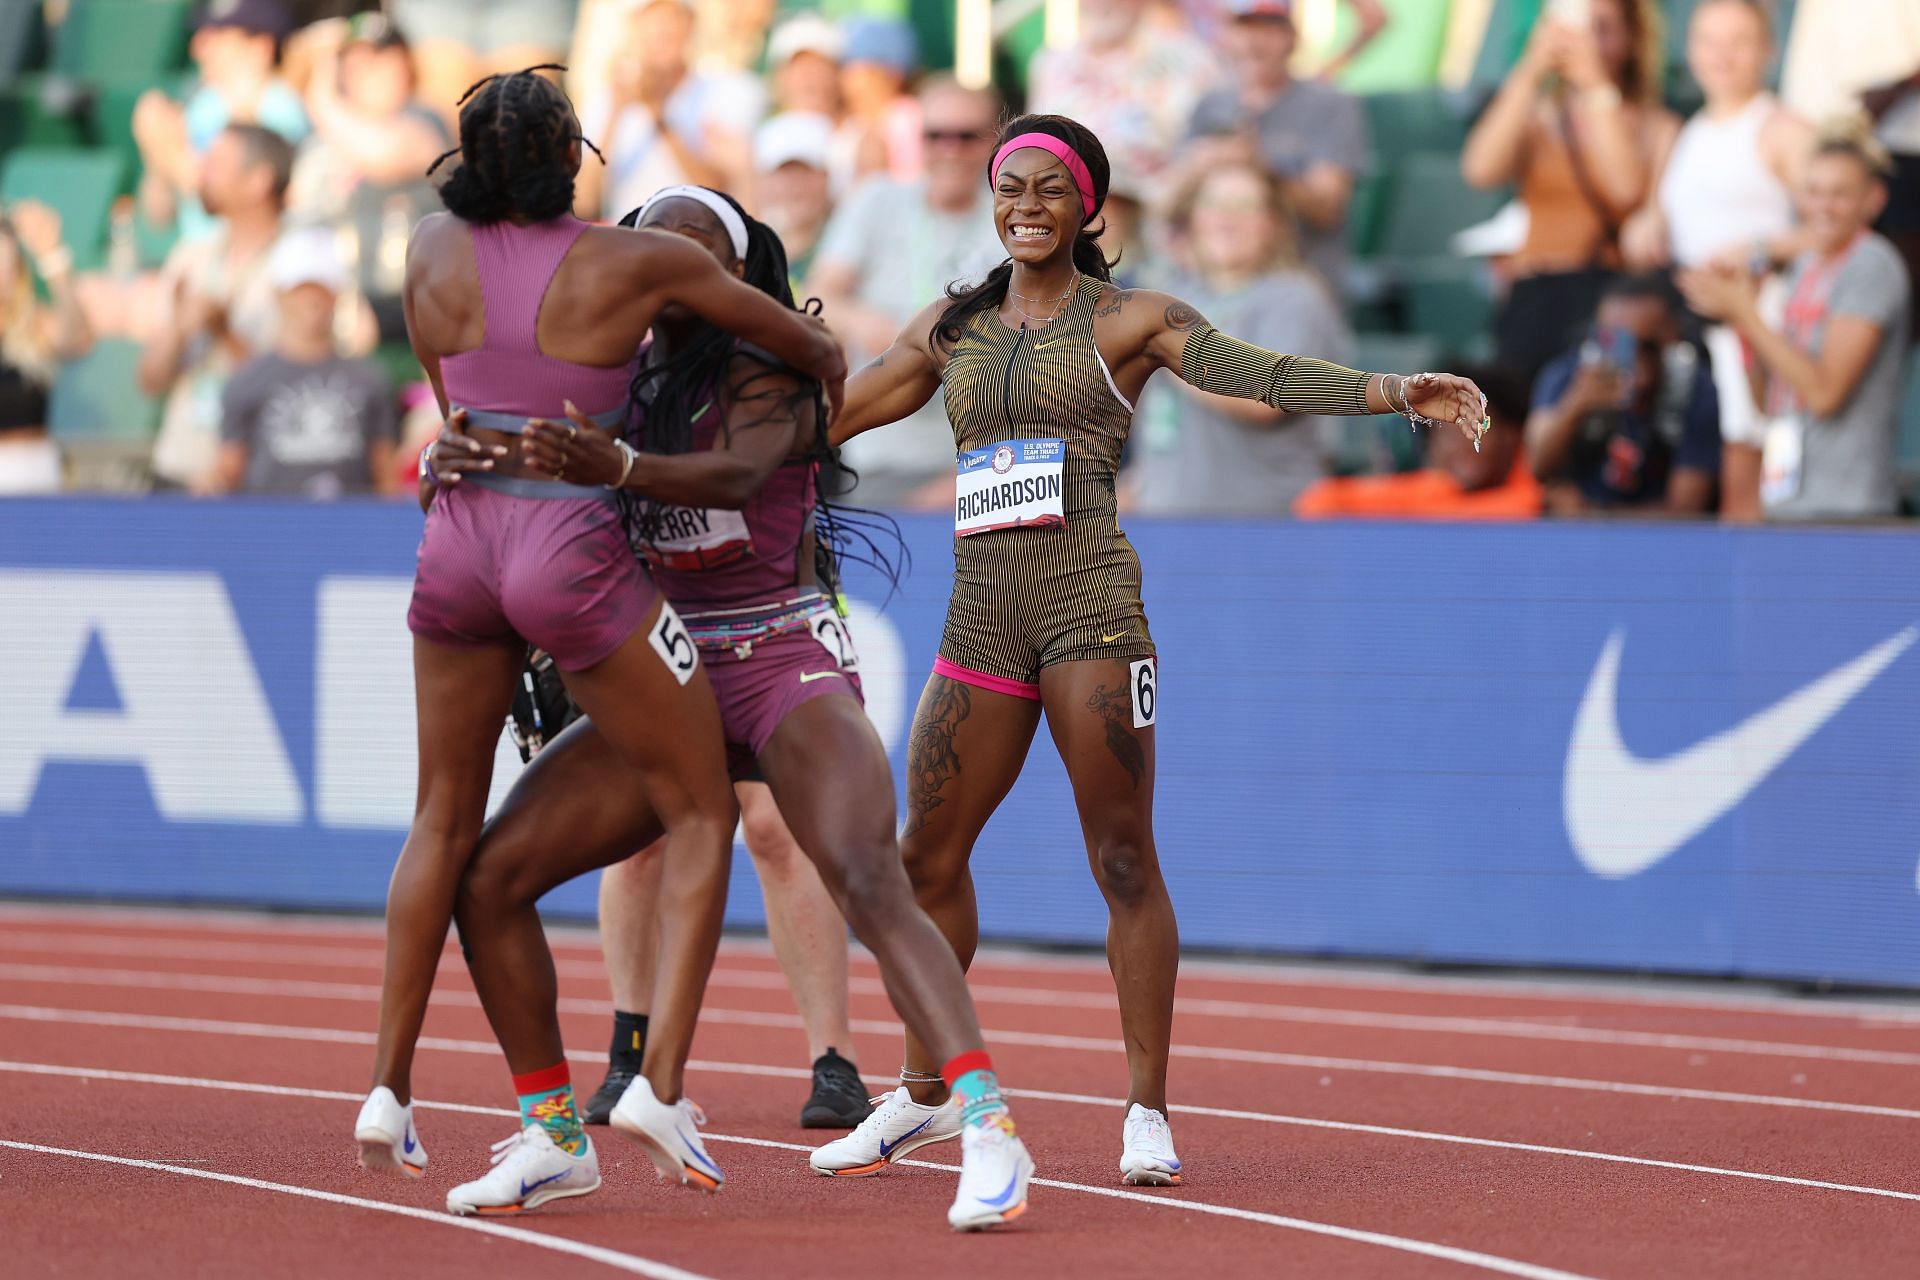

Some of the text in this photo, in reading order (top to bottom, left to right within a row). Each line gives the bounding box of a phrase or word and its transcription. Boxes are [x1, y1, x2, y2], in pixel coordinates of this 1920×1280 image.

[958, 474, 1060, 522] RICHARDSON
[656, 507, 710, 541] ERRY
[659, 615, 693, 670] 5
[1137, 664, 1154, 721] 6
